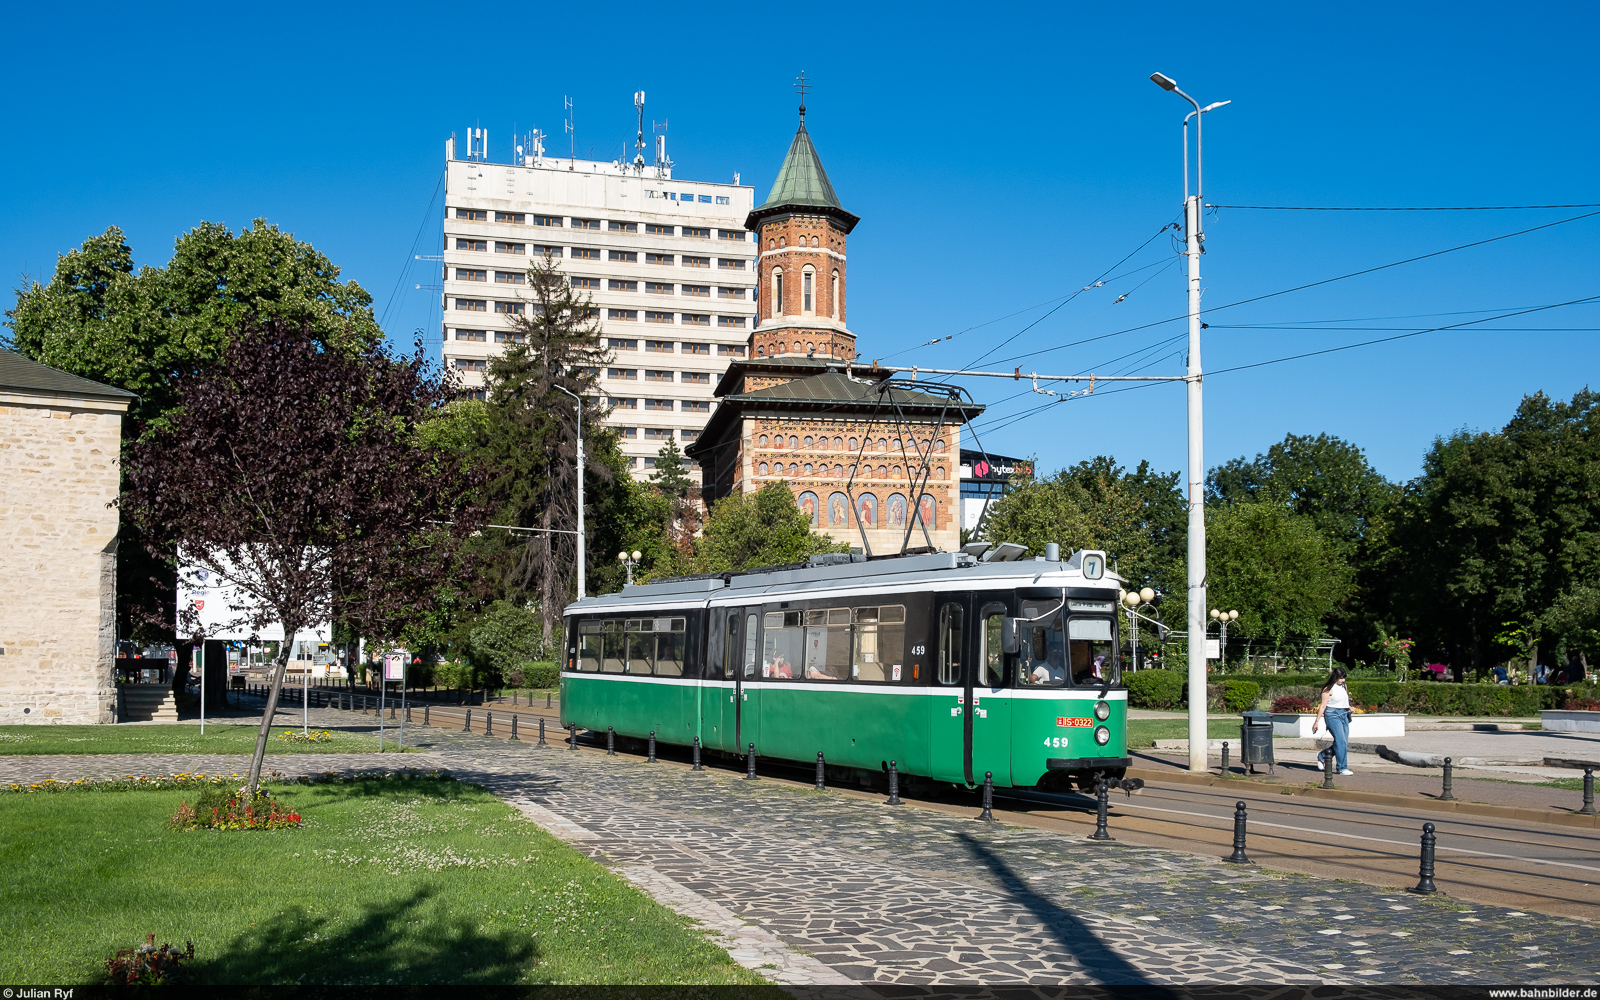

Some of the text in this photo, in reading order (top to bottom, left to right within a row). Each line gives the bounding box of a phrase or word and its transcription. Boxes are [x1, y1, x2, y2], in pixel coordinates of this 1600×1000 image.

[1088, 561, 1096, 576] 7
[911, 645, 925, 655] 459
[1043, 736, 1069, 748] 459
